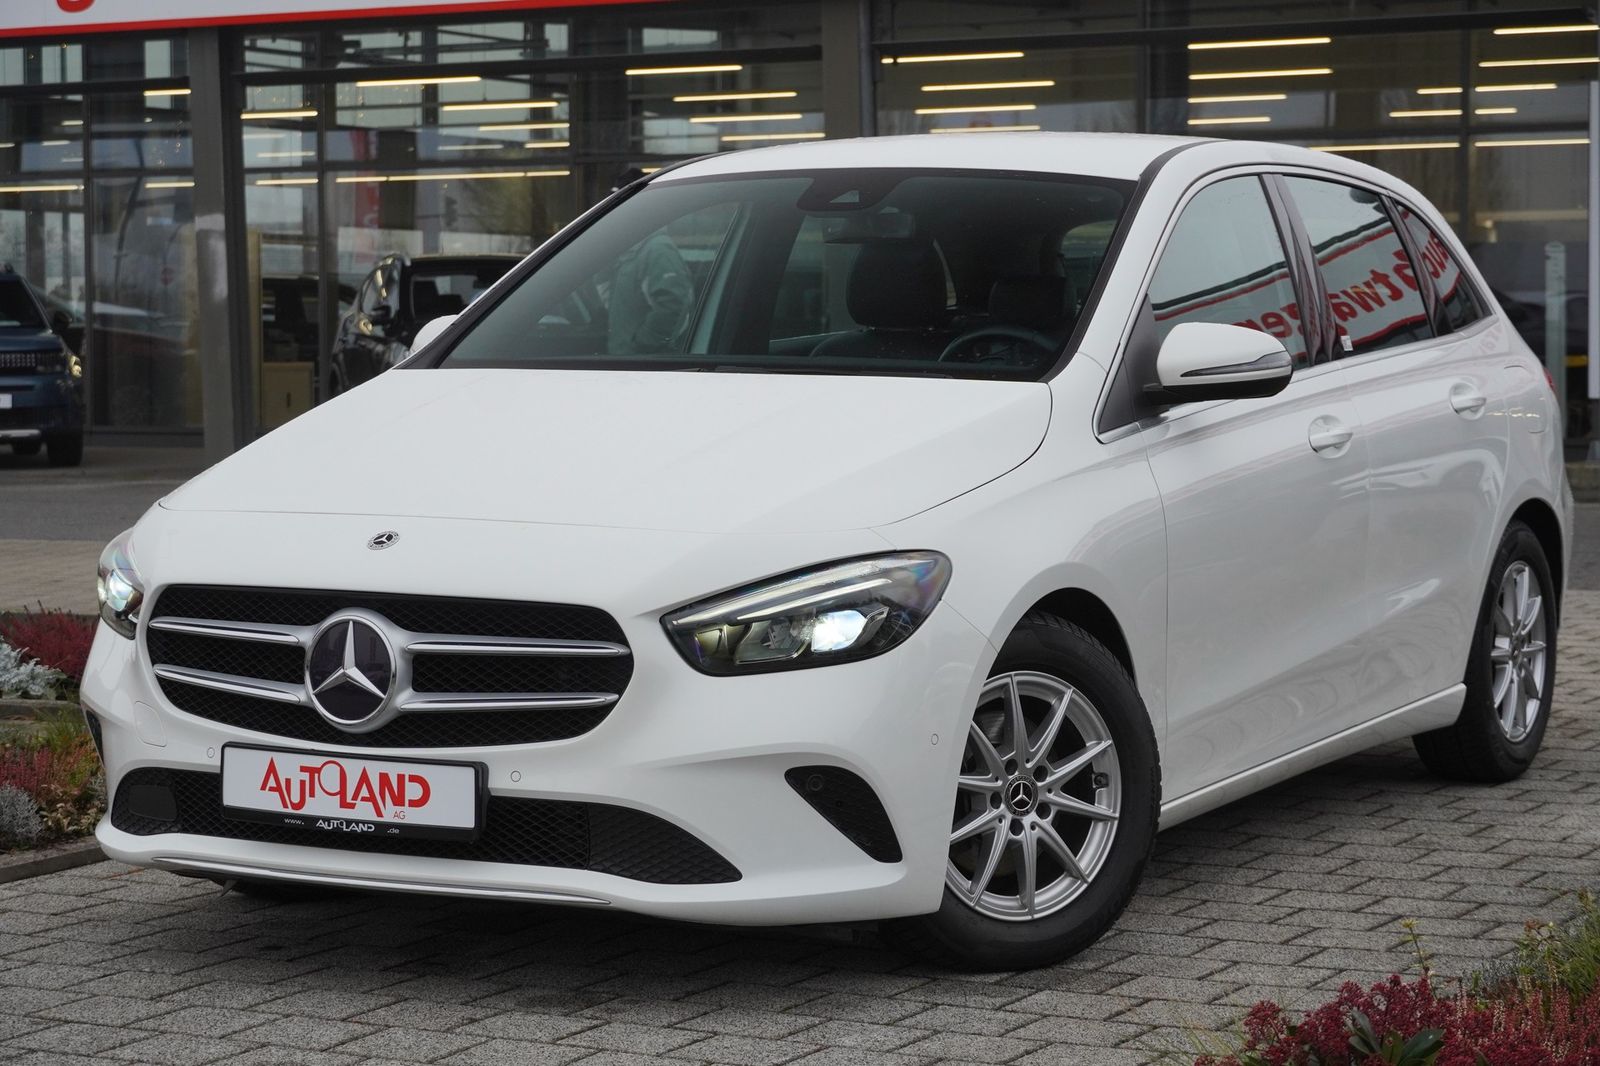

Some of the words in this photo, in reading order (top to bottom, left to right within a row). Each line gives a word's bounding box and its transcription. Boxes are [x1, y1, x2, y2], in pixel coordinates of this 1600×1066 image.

[260, 757, 431, 818] AUTOLAND
[392, 811, 406, 820] AG
[284, 817, 305, 825] www.
[316, 819, 375, 833] AUTOLAND
[387, 827, 400, 835] .de
